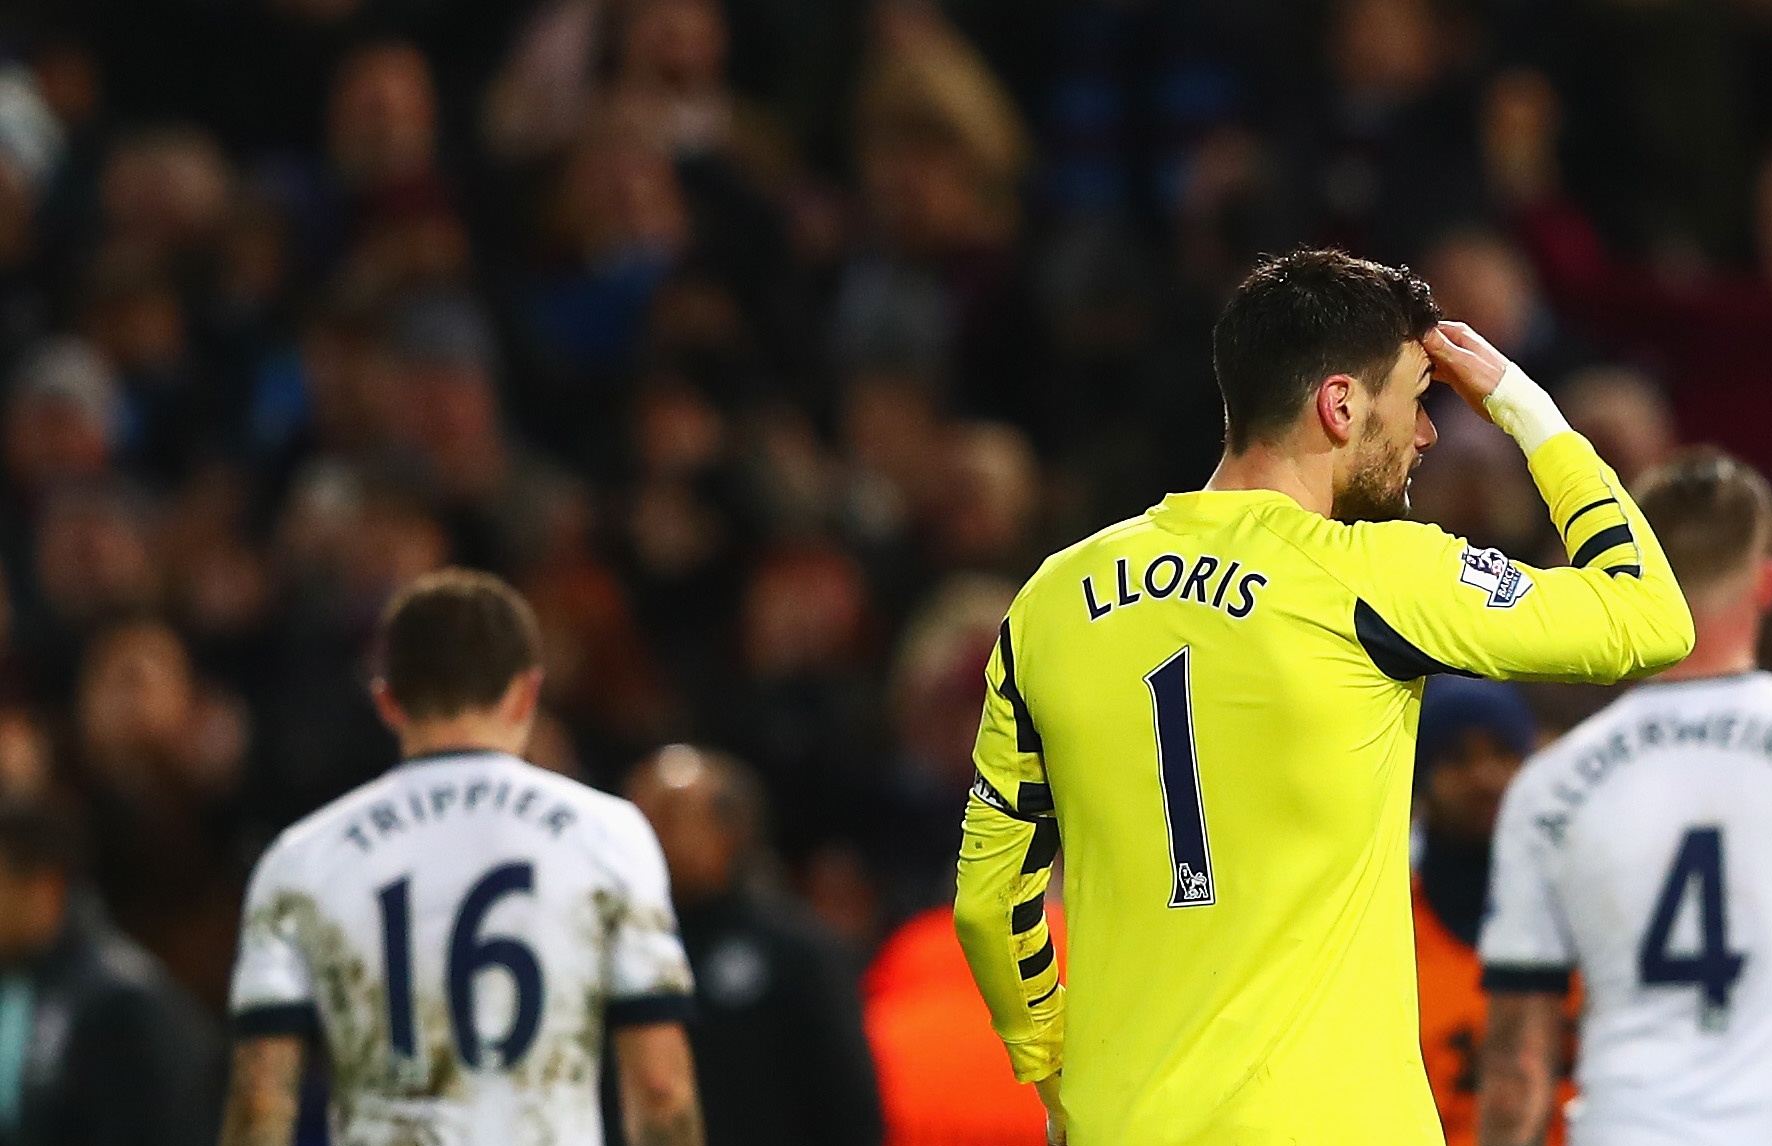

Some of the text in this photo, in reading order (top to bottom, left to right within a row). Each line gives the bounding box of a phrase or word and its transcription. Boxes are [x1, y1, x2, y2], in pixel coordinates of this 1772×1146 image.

[1080, 553, 1269, 623] LLORIS
[342, 776, 580, 855] TRIPPIER
[1142, 645, 1215, 909] 1
[374, 860, 546, 1076] 16
[1637, 823, 1750, 1033] 4
